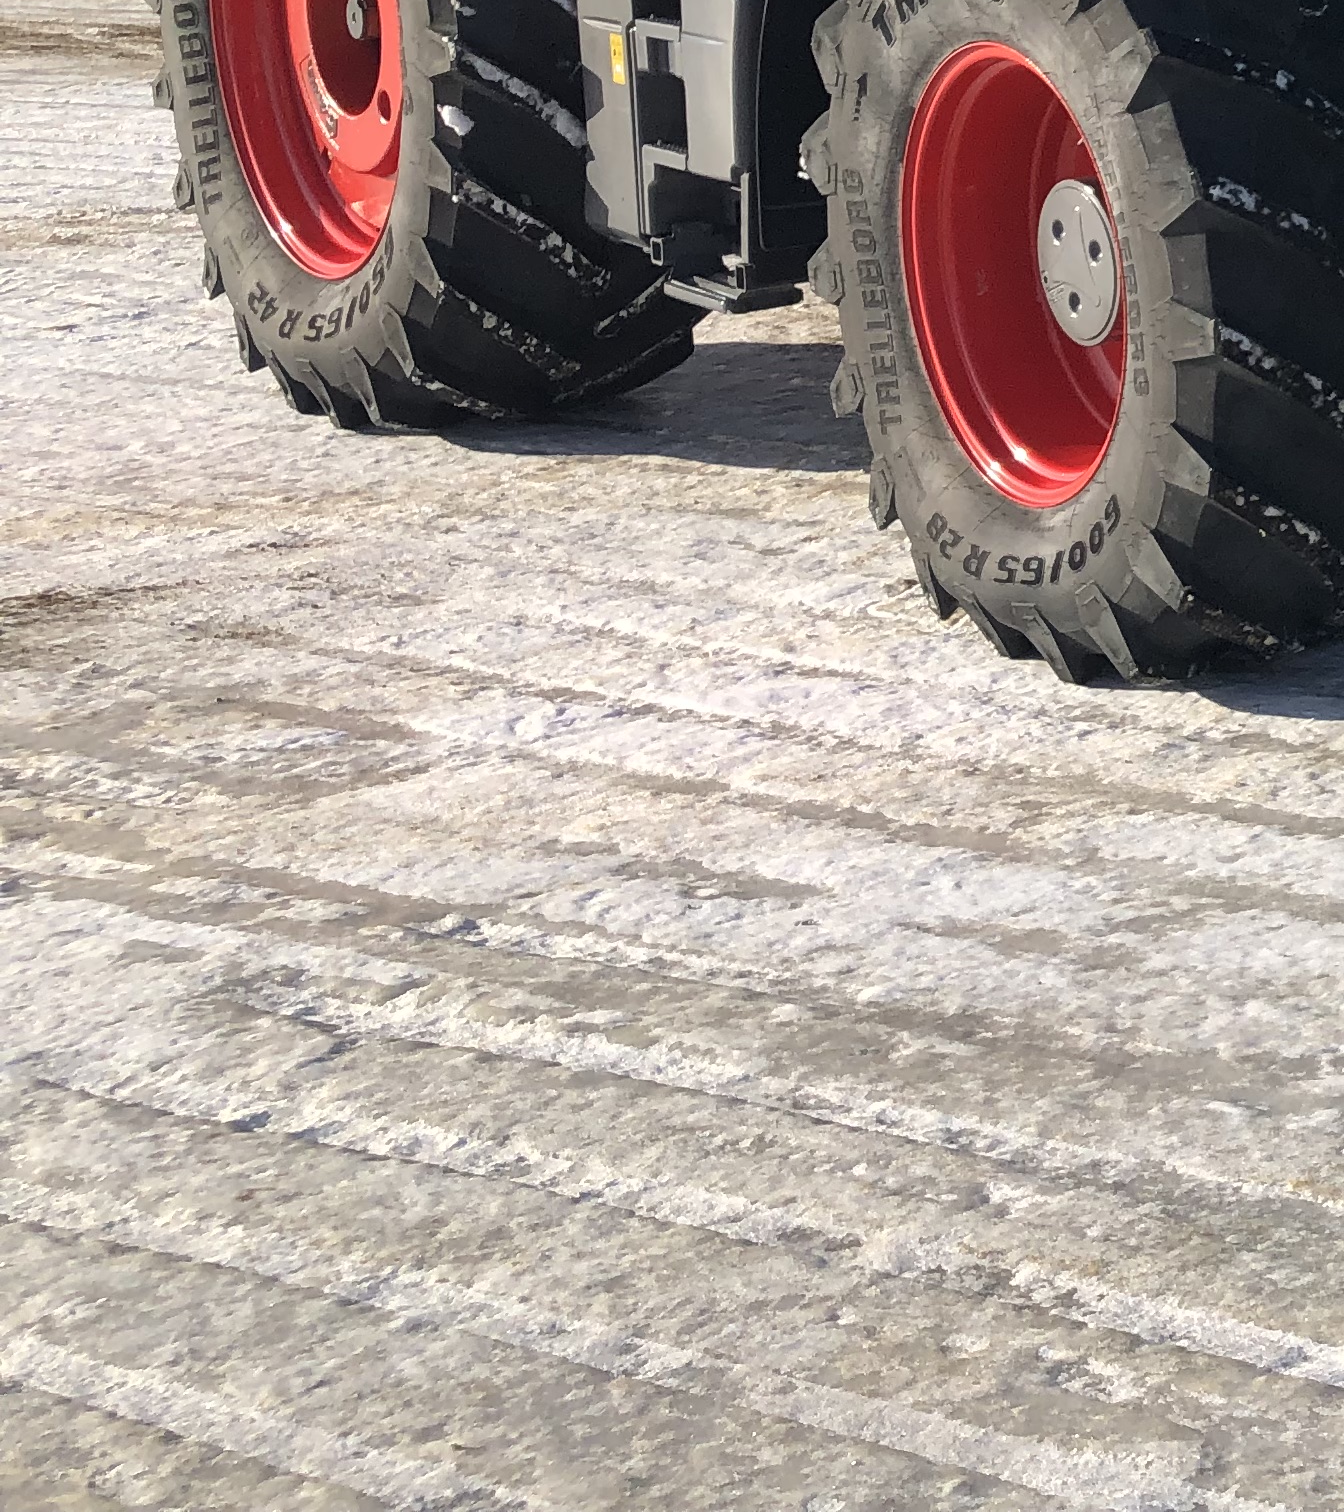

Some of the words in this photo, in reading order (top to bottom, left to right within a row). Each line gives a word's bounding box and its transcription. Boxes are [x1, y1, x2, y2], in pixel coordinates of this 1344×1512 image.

[247, 281, 279, 323] 42
[278, 308, 303, 340] R
[841, 168, 902, 436] TRELLEBORG
[926, 512, 965, 561] 28
[993, 494, 1122, 586] 600/65
[962, 543, 992, 580] R
